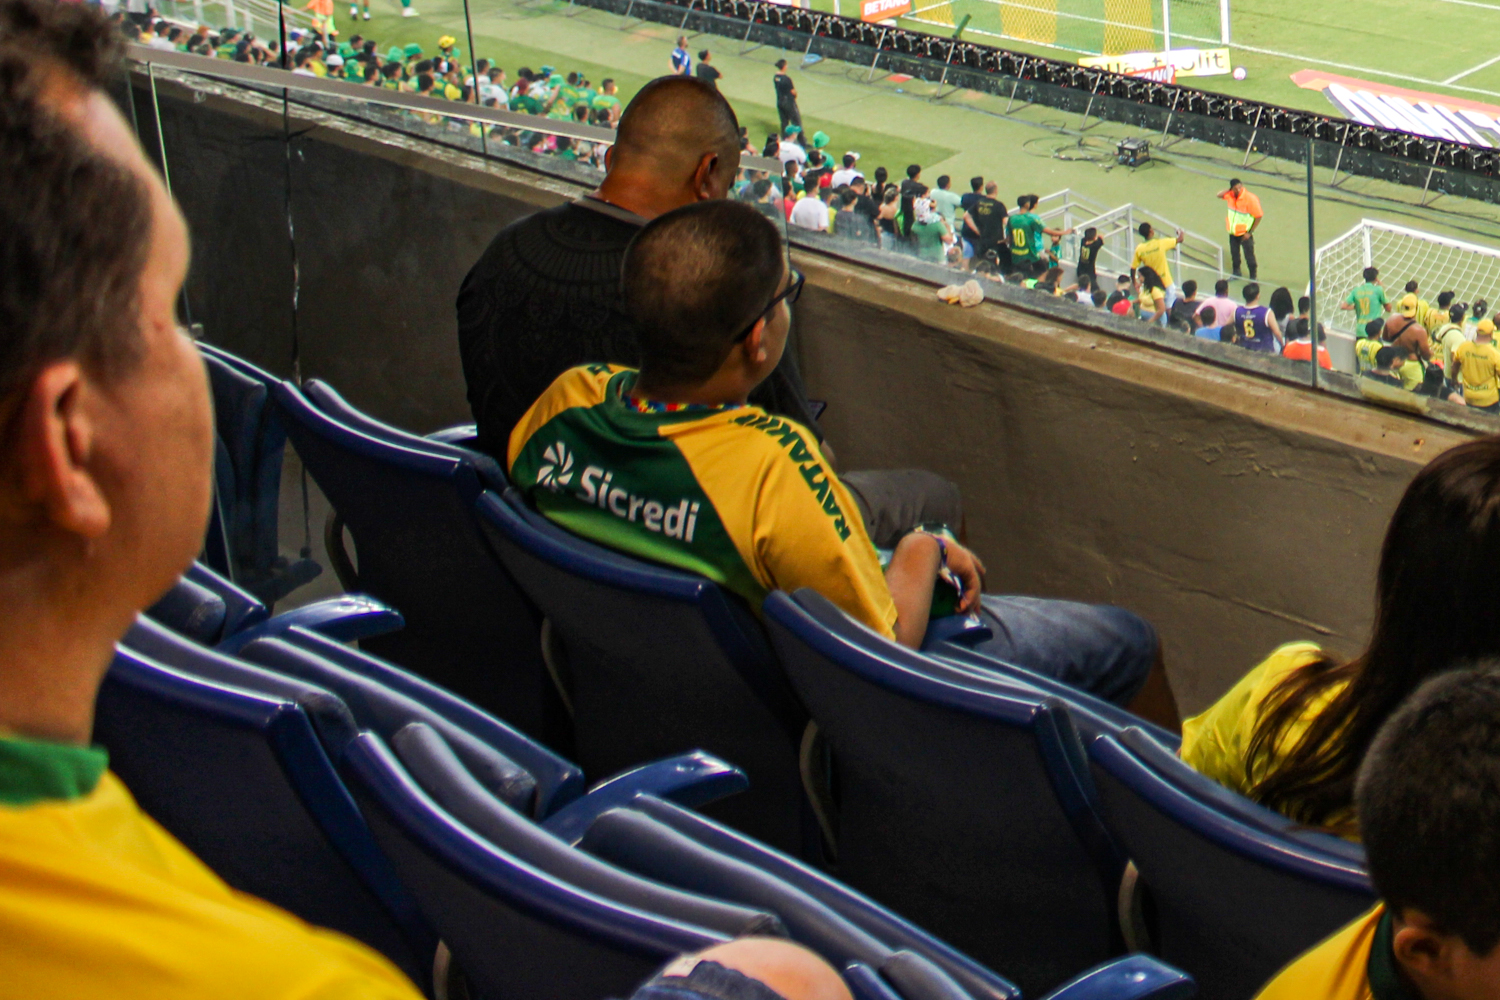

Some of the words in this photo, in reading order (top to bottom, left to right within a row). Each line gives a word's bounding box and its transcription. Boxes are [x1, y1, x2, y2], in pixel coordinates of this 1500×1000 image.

[1012, 228, 1026, 248] 10
[1243, 319, 1256, 339] 6
[577, 464, 700, 543] Sicredi
